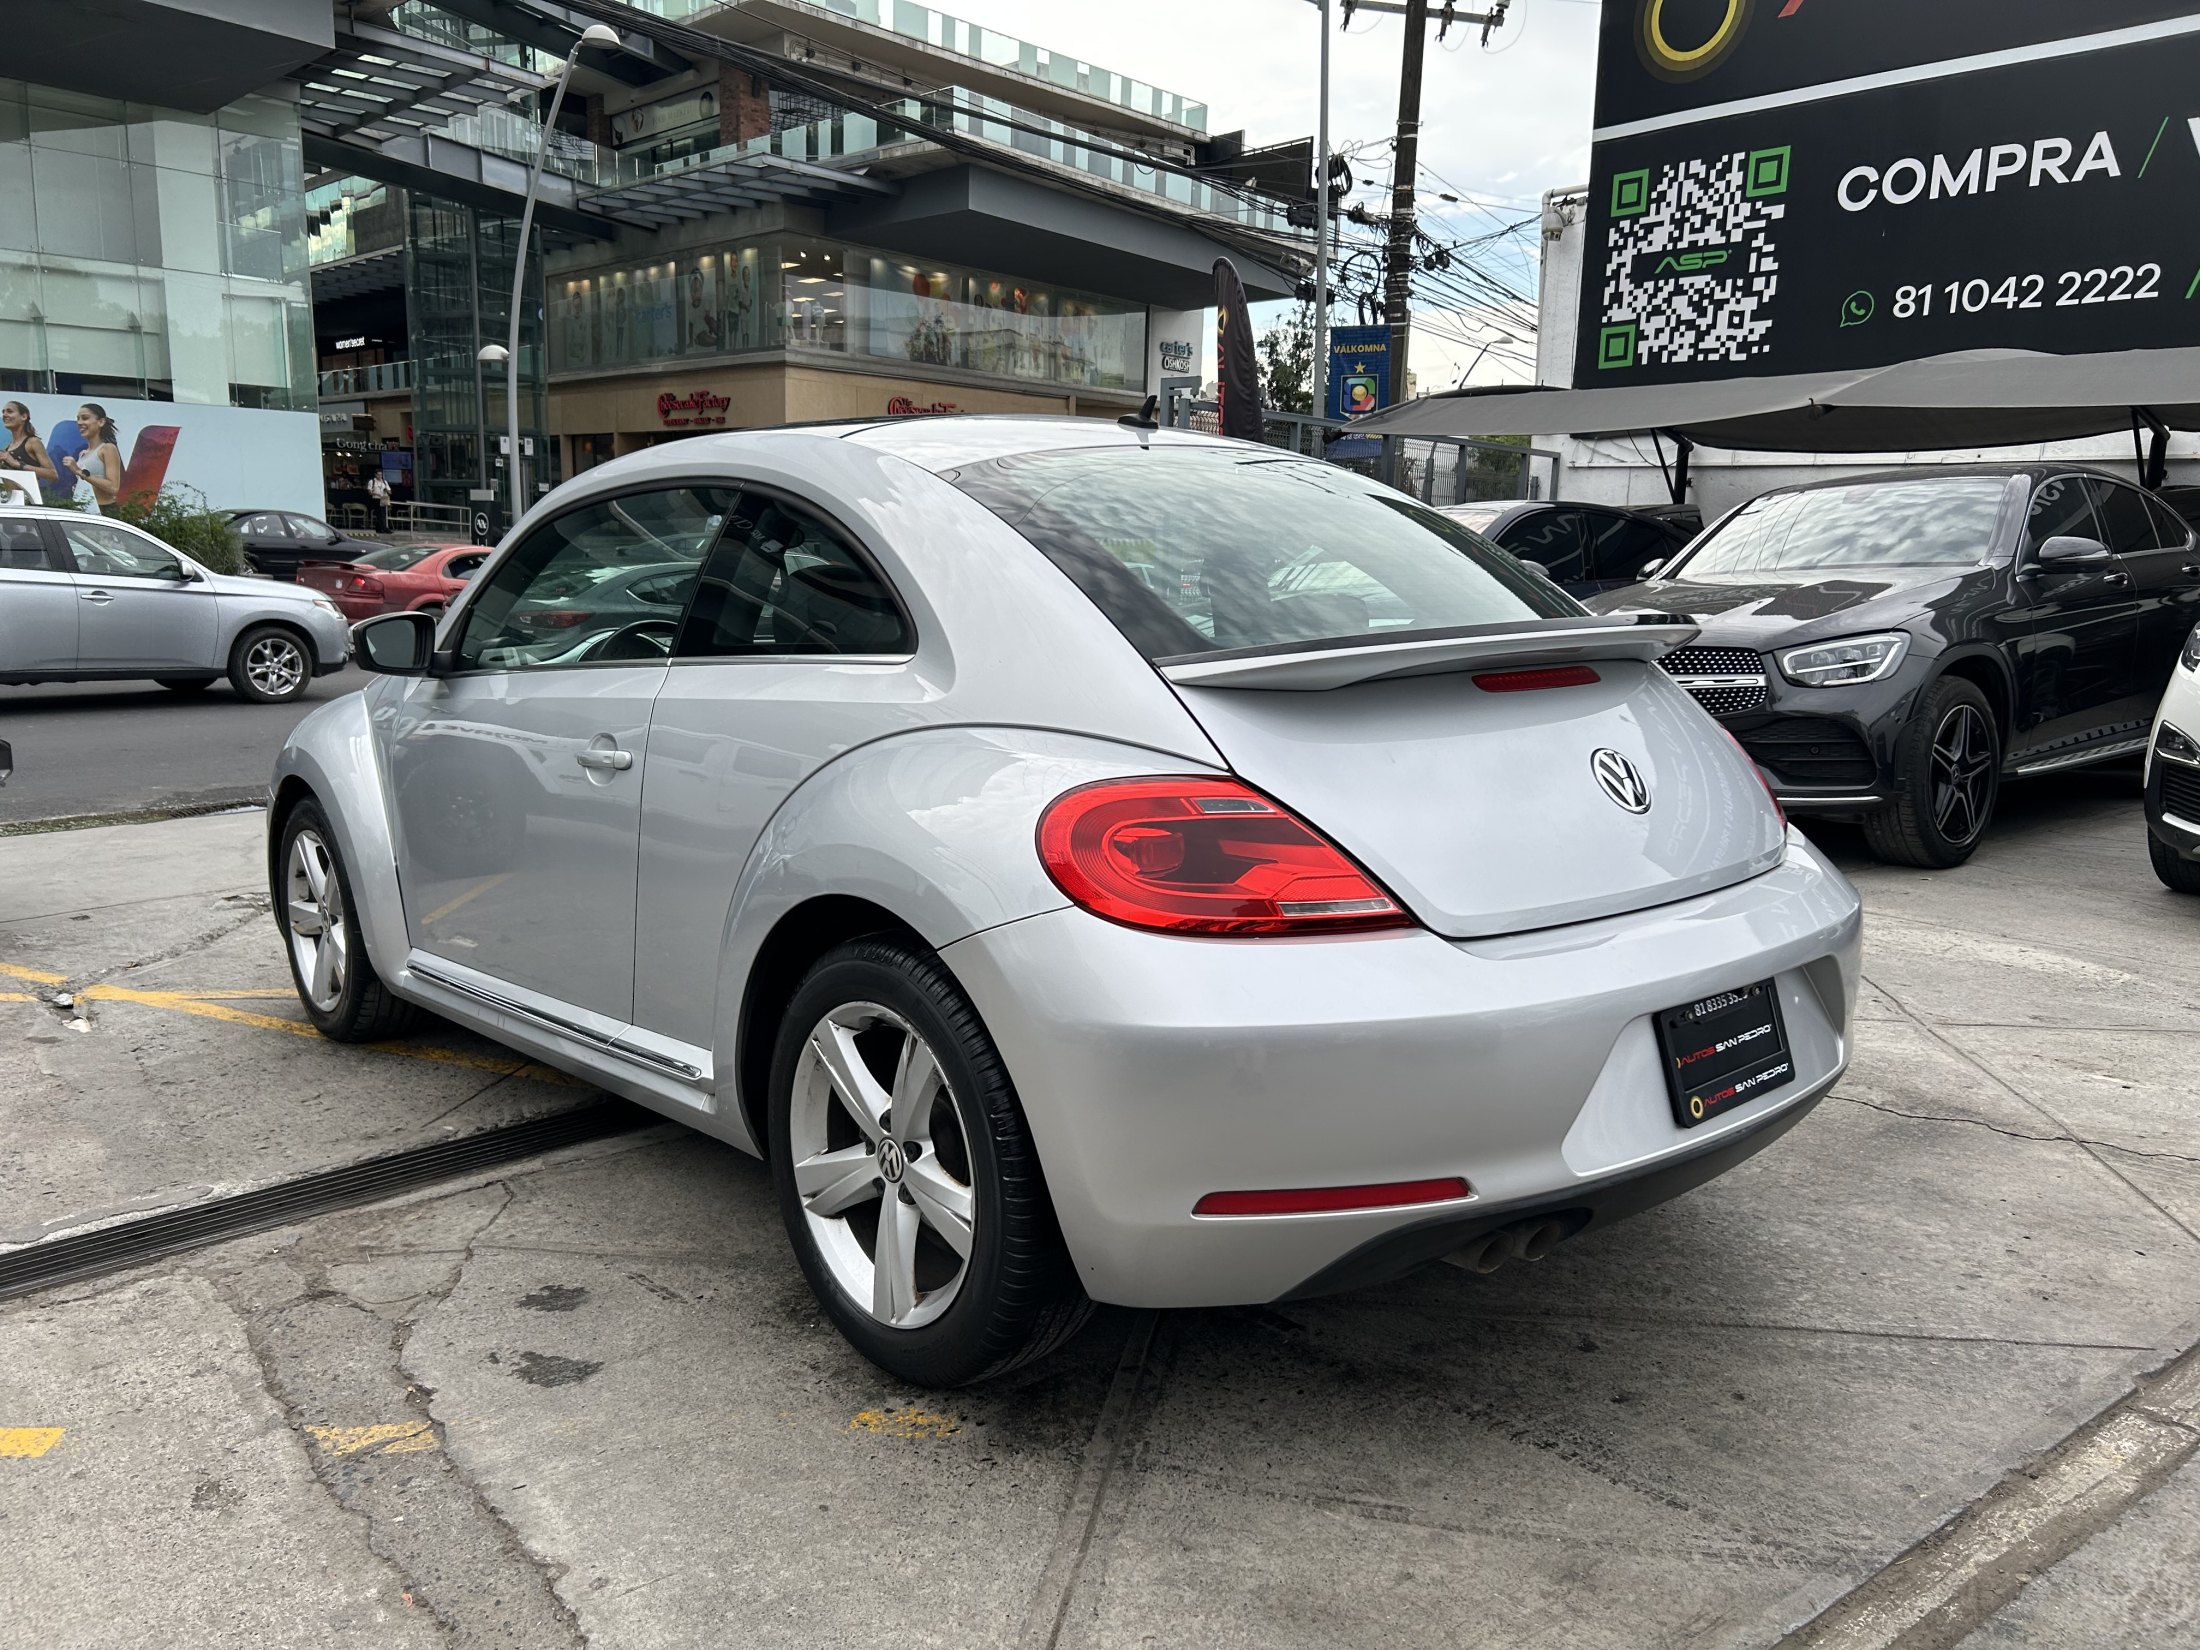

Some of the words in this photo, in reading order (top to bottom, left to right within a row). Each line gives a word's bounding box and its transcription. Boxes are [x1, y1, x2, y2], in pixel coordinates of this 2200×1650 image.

[1837, 131, 2121, 212] COMPRA
[1654, 250, 1728, 274] ASP
[1892, 284, 1933, 318] 81
[1944, 274, 2044, 314] 1042
[2055, 263, 2161, 306] 2222
[336, 437, 367, 452] Gong
[1694, 1002, 1707, 1017] 81
[1727, 992, 1748, 1005] 35
[1680, 1046, 1716, 1066] AUTOS
[1715, 1037, 1738, 1052] SAN
[1737, 1025, 1771, 1044] PEDRO
[1703, 1087, 1736, 1107] AUTOS
[1734, 1077, 1756, 1093] SAN
[1755, 1064, 1787, 1084] PEDRO
